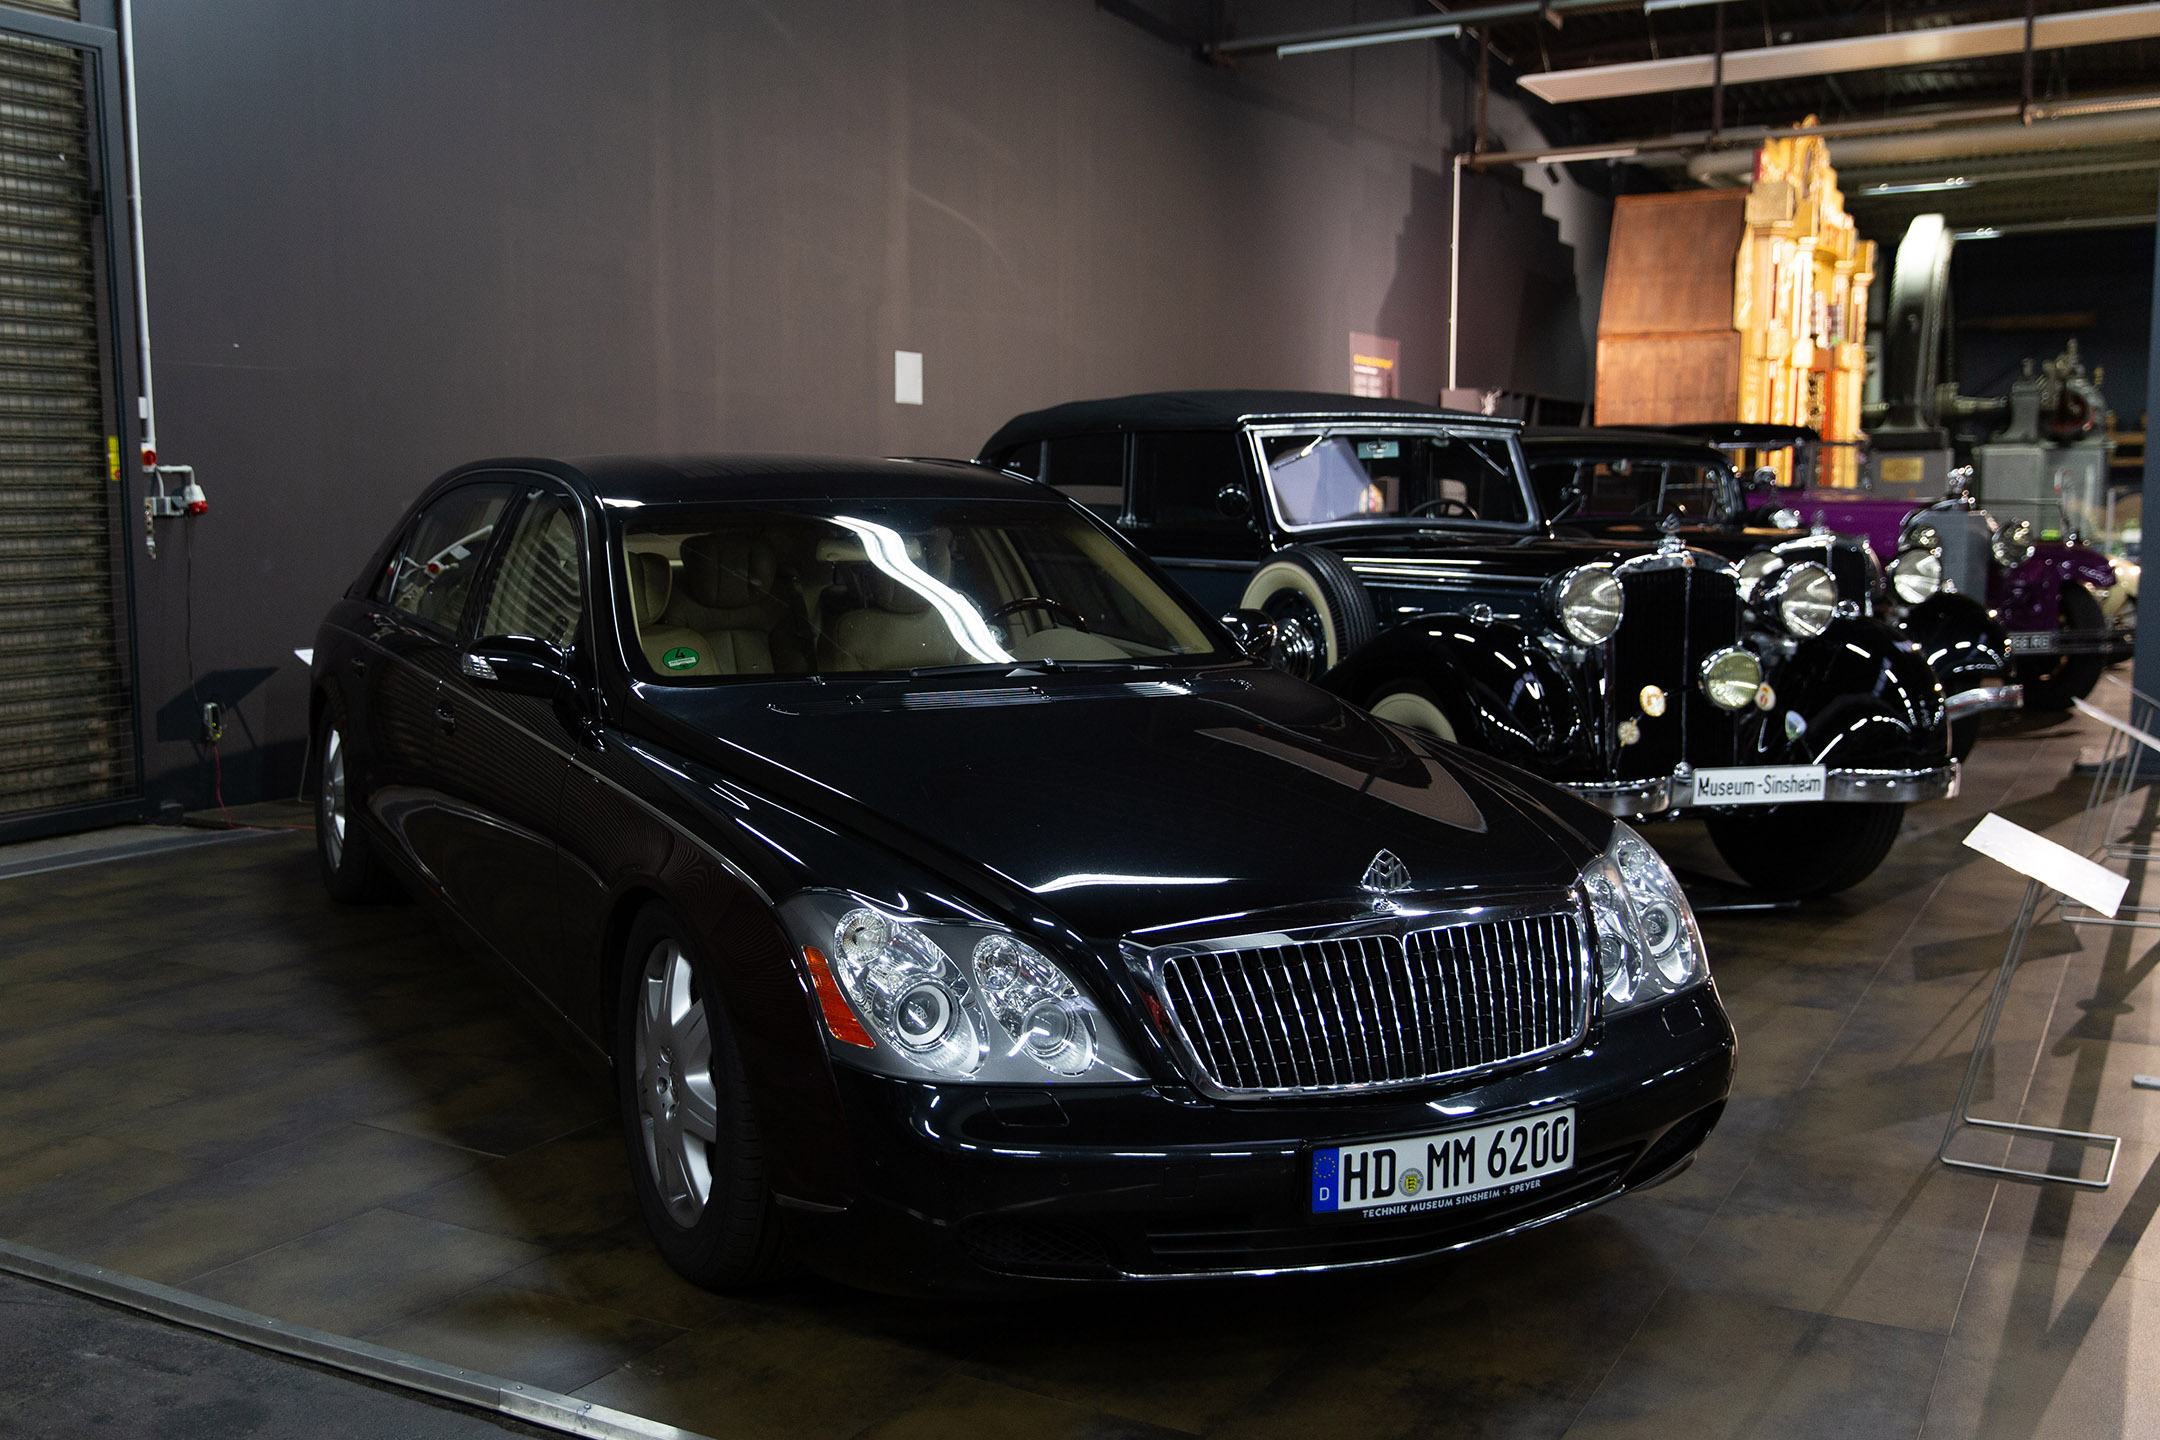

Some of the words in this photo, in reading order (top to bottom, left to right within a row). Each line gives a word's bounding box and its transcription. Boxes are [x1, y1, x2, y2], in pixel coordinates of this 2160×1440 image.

[675, 648, 686, 659] 4
[1342, 1148, 1397, 1203] HD
[1426, 1135, 1476, 1191] MM
[1487, 1115, 1569, 1179] 6200
[1319, 1187, 1330, 1201] D
[1362, 1204, 1408, 1219] TECHNIK
[1410, 1198, 1454, 1213] MUSEUM
[1455, 1190, 1501, 1206] SINSHEIM
[1509, 1179, 1542, 1196] SPEYER
